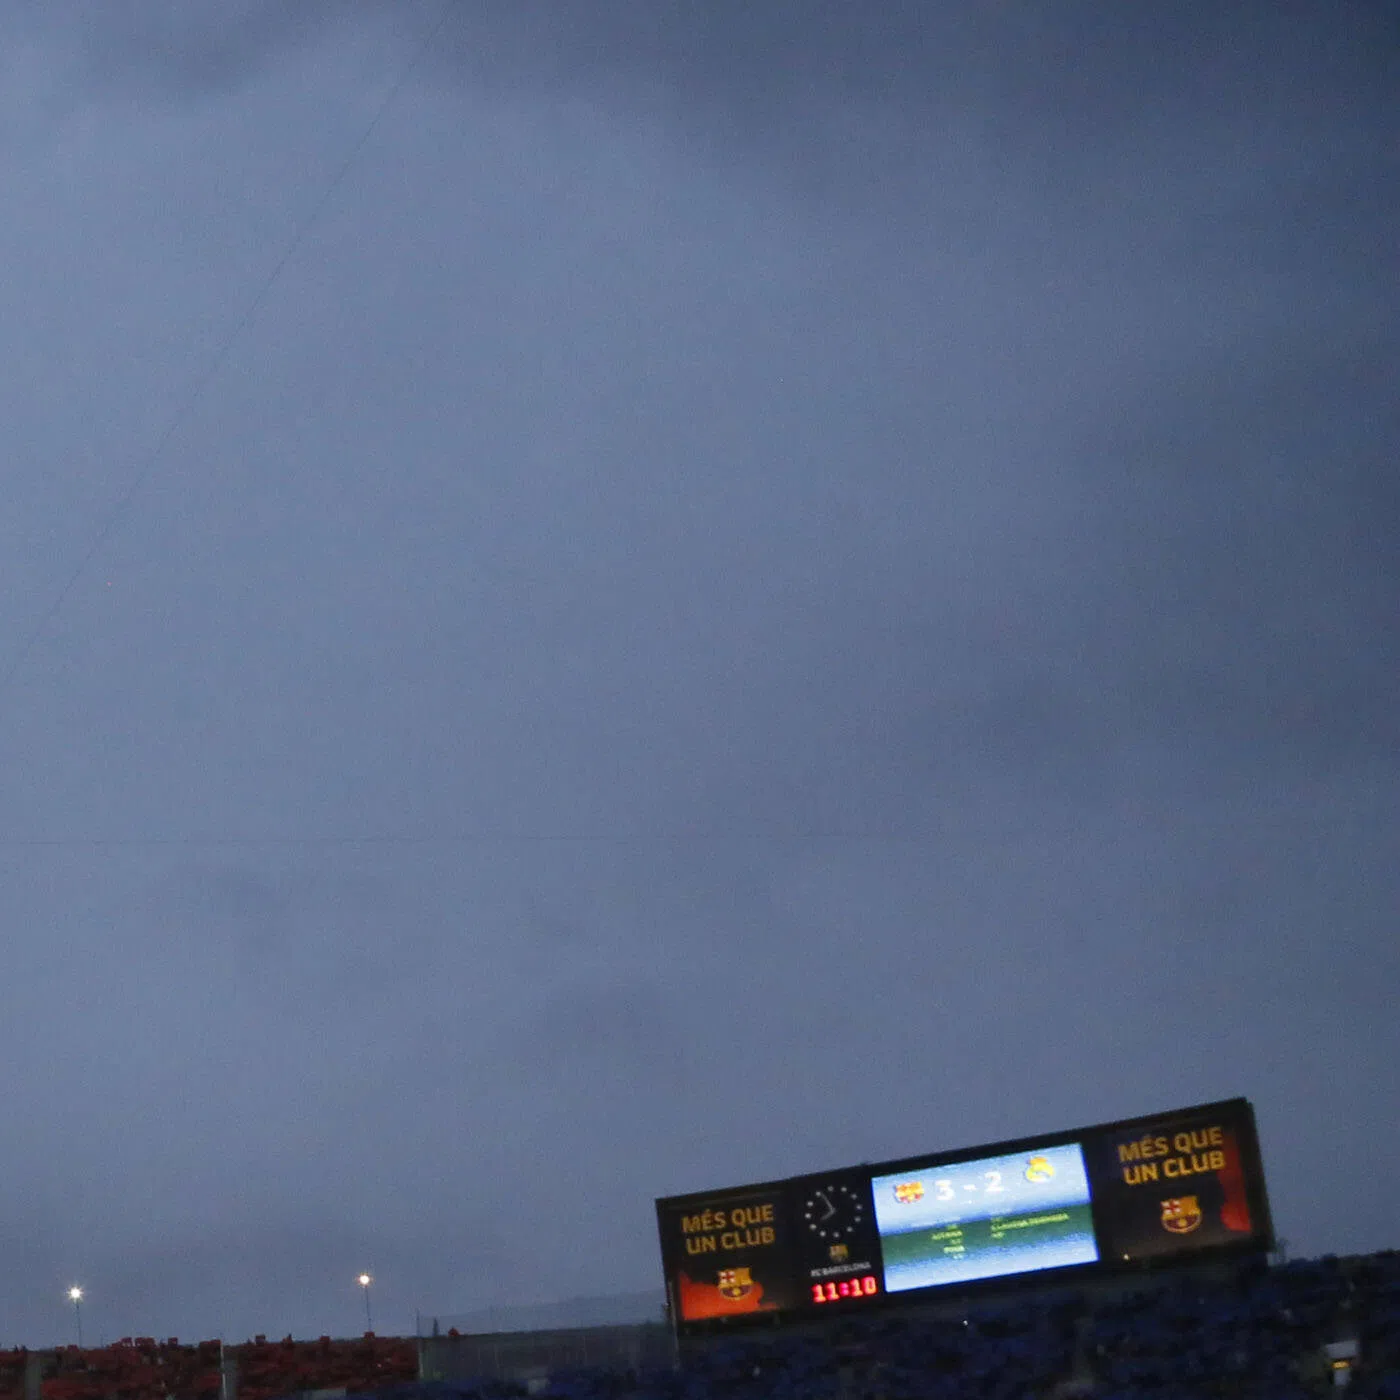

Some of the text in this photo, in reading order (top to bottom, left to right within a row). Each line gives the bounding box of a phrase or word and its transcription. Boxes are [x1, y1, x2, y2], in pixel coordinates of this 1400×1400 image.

[1117, 1126, 1223, 1162] MÉS QUE
[984, 1171, 1004, 1192] 2
[1123, 1150, 1226, 1185] UN CLUB
[682, 1204, 774, 1233] MÉS QUE
[686, 1226, 775, 1255] UN CLUB
[811, 1276, 877, 1303] 11:10
